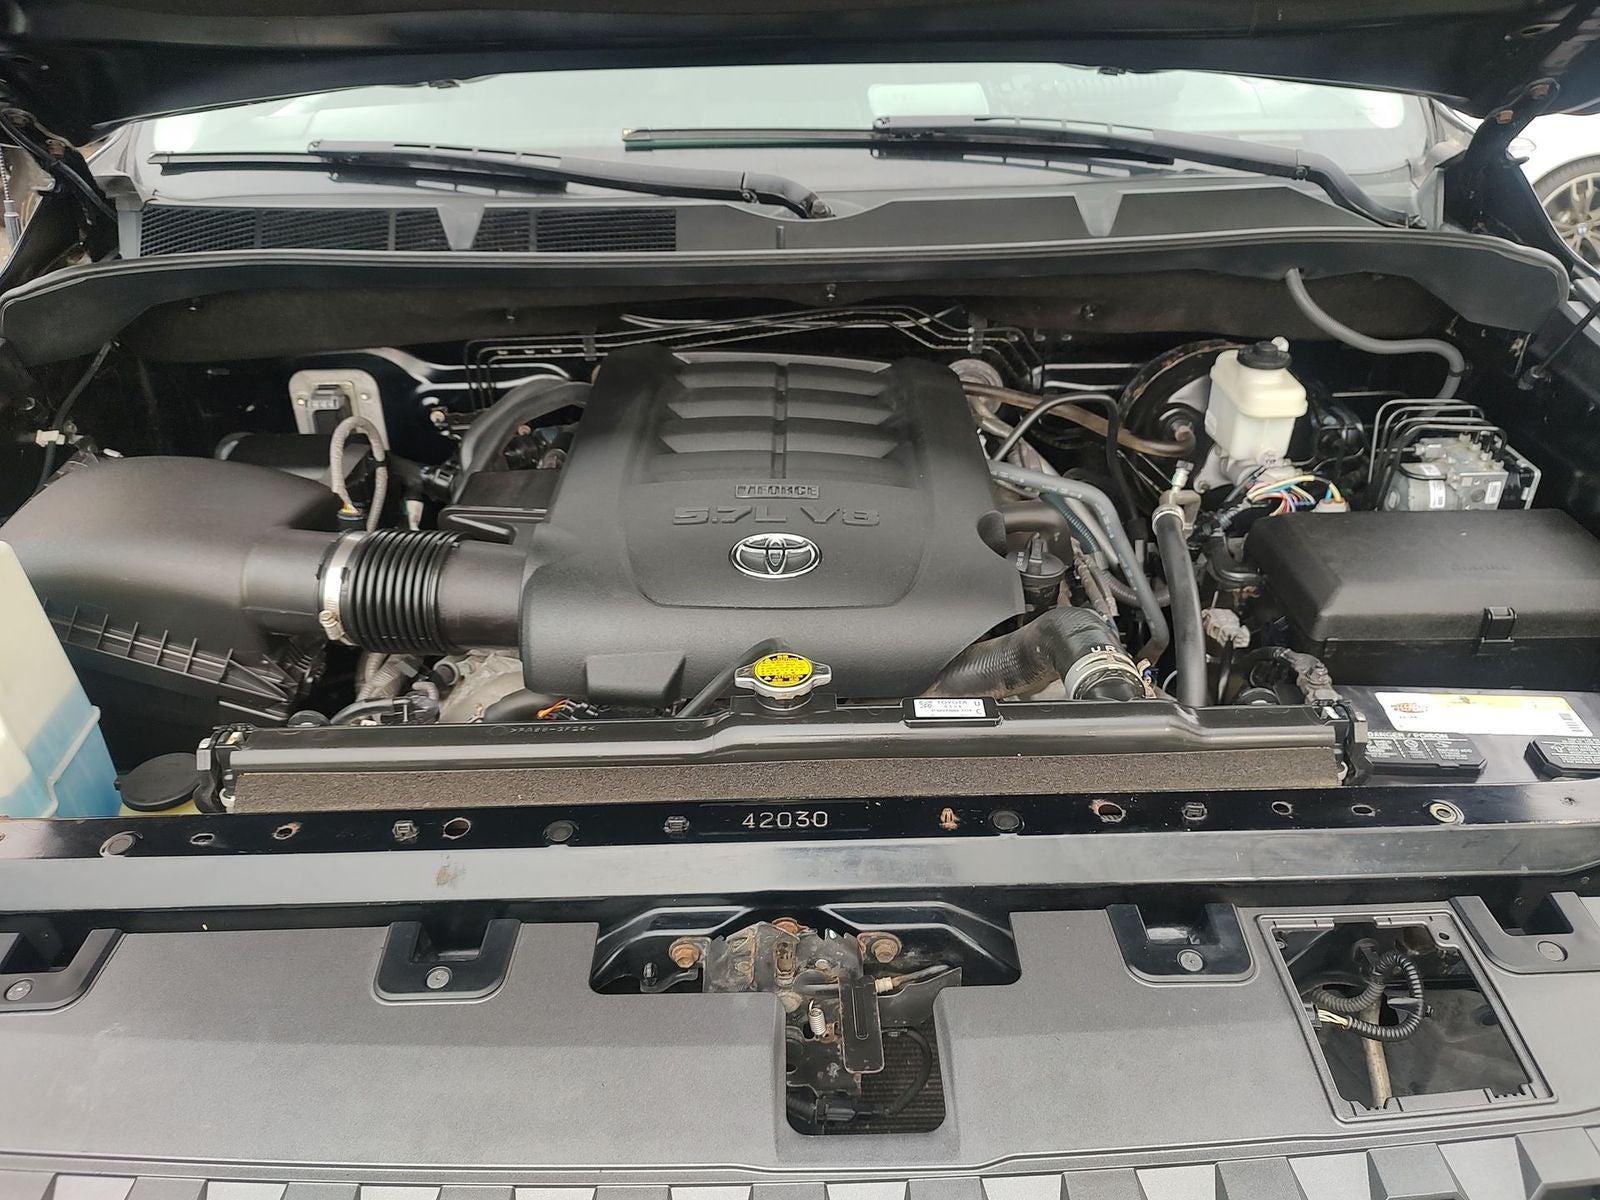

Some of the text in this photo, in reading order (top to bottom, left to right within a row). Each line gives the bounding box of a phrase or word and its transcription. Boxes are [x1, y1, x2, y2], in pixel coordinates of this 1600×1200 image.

[672, 506, 881, 527] 5.7L V8
[742, 811, 829, 828] 42030
